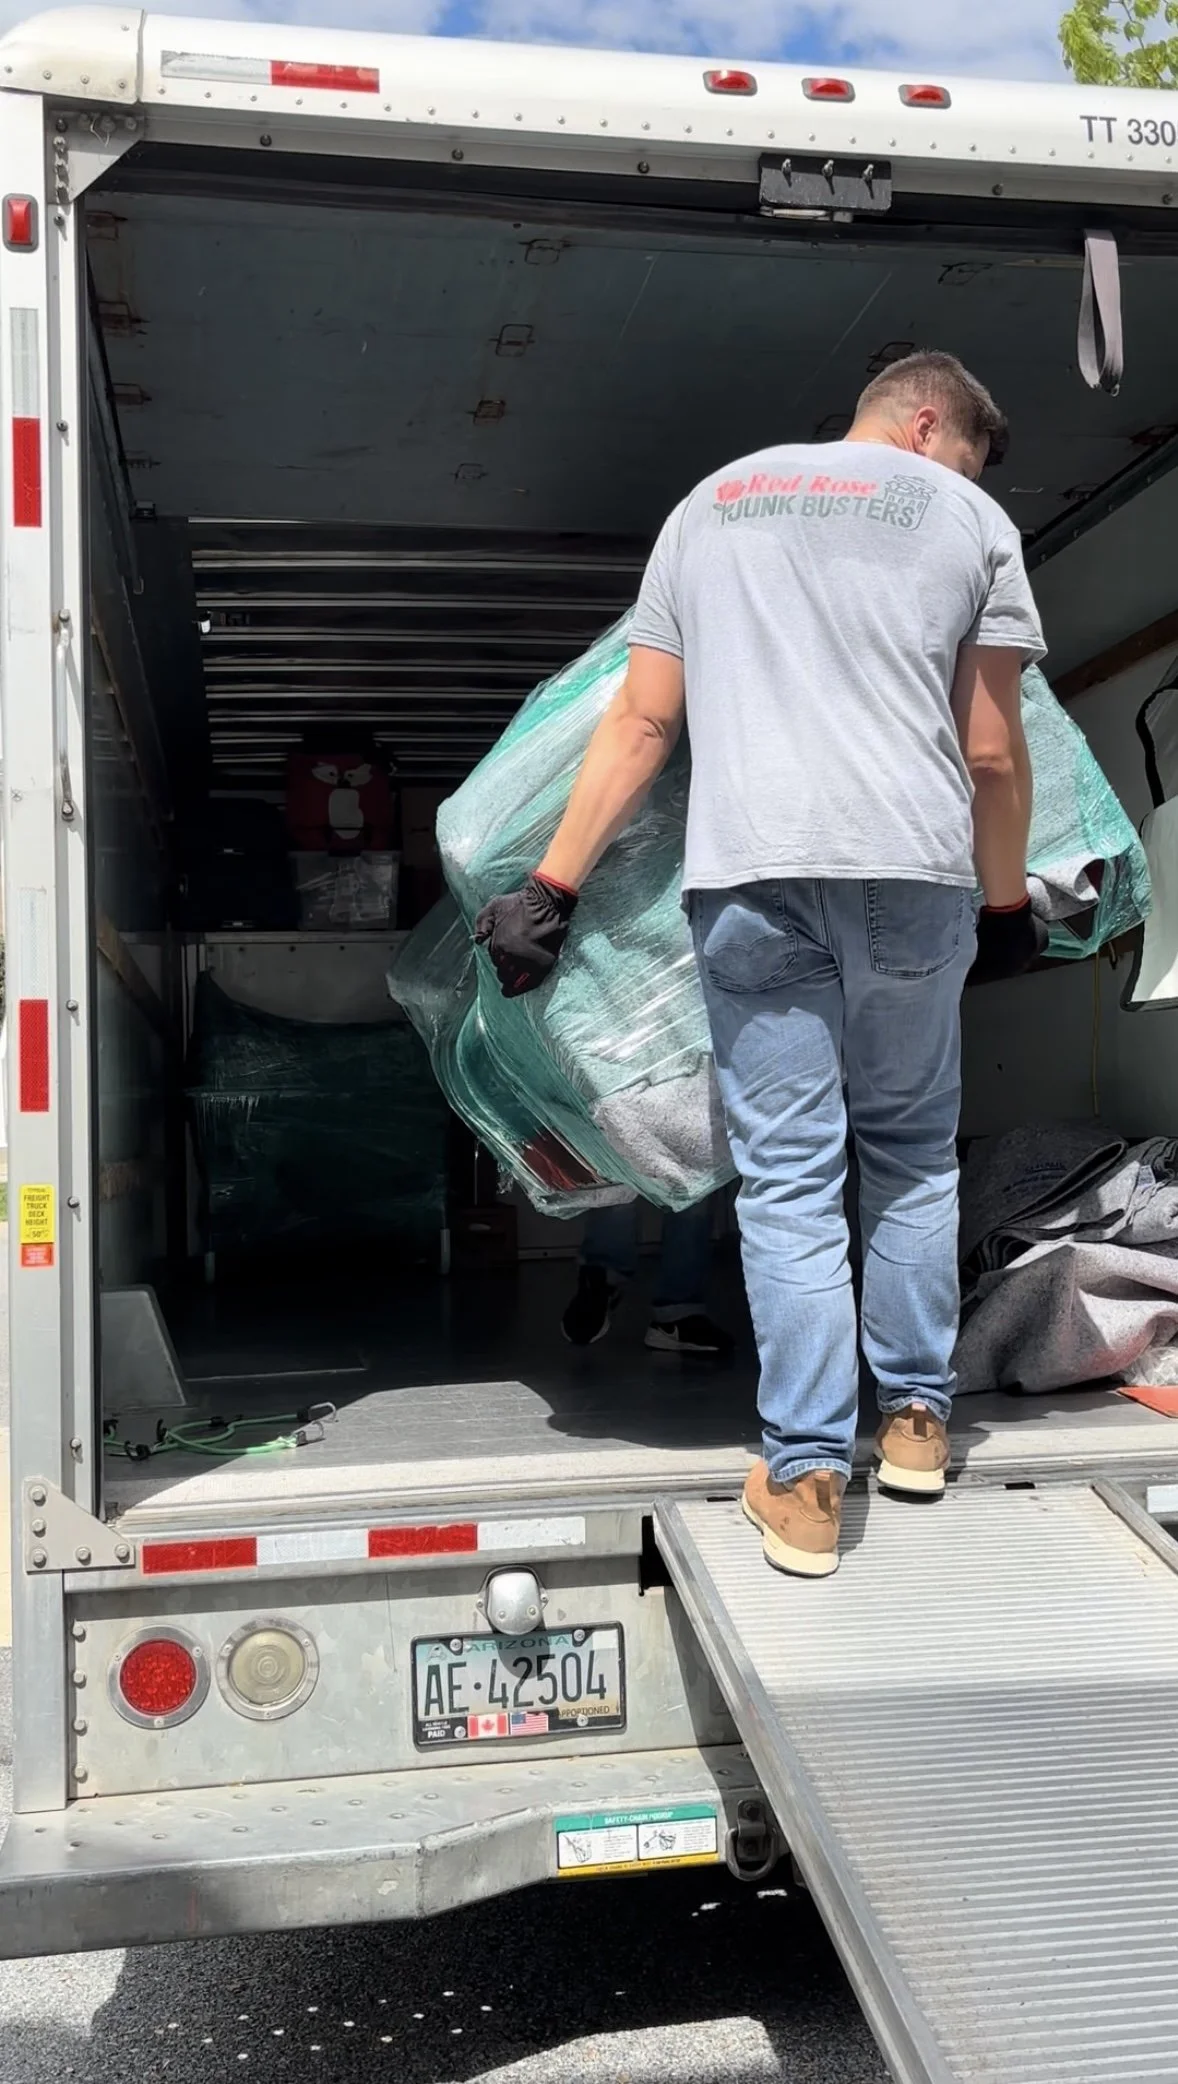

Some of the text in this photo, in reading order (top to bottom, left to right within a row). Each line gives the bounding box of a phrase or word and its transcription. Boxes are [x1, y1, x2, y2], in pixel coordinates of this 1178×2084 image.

[1079, 115, 1178, 147] TT 330
[750, 473, 878, 494] Red Rose
[727, 495, 917, 529] JUNK BUSTERS
[26, 1202, 47, 1210] TRUCK
[467, 1636, 570, 1653] ARIZONA
[557, 1705, 610, 1718] PPORTIONED
[427, 1729, 446, 1739] PAID
